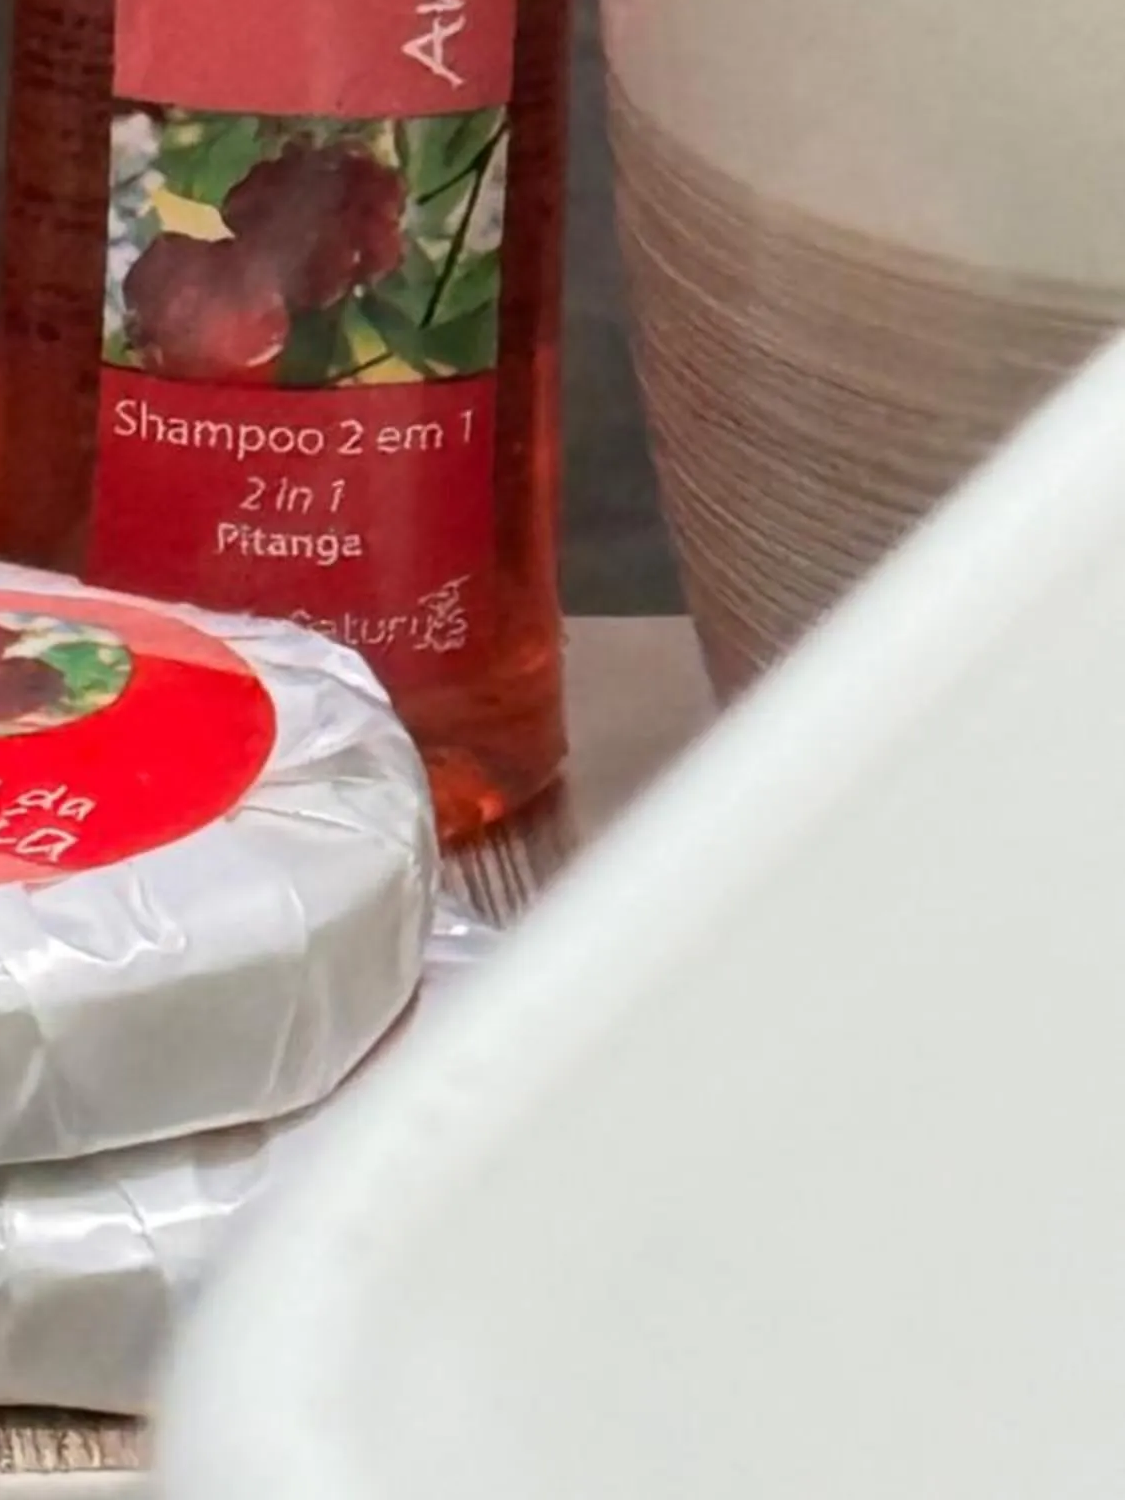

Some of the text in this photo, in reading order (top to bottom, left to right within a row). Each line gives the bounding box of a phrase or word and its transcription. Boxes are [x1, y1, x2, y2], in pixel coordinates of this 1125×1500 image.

[114, 400, 474, 460] Shampoo 2 em 1
[240, 476, 346, 514] 2 in 1
[216, 522, 363, 566] Pitanga
[18, 785, 96, 824] da
